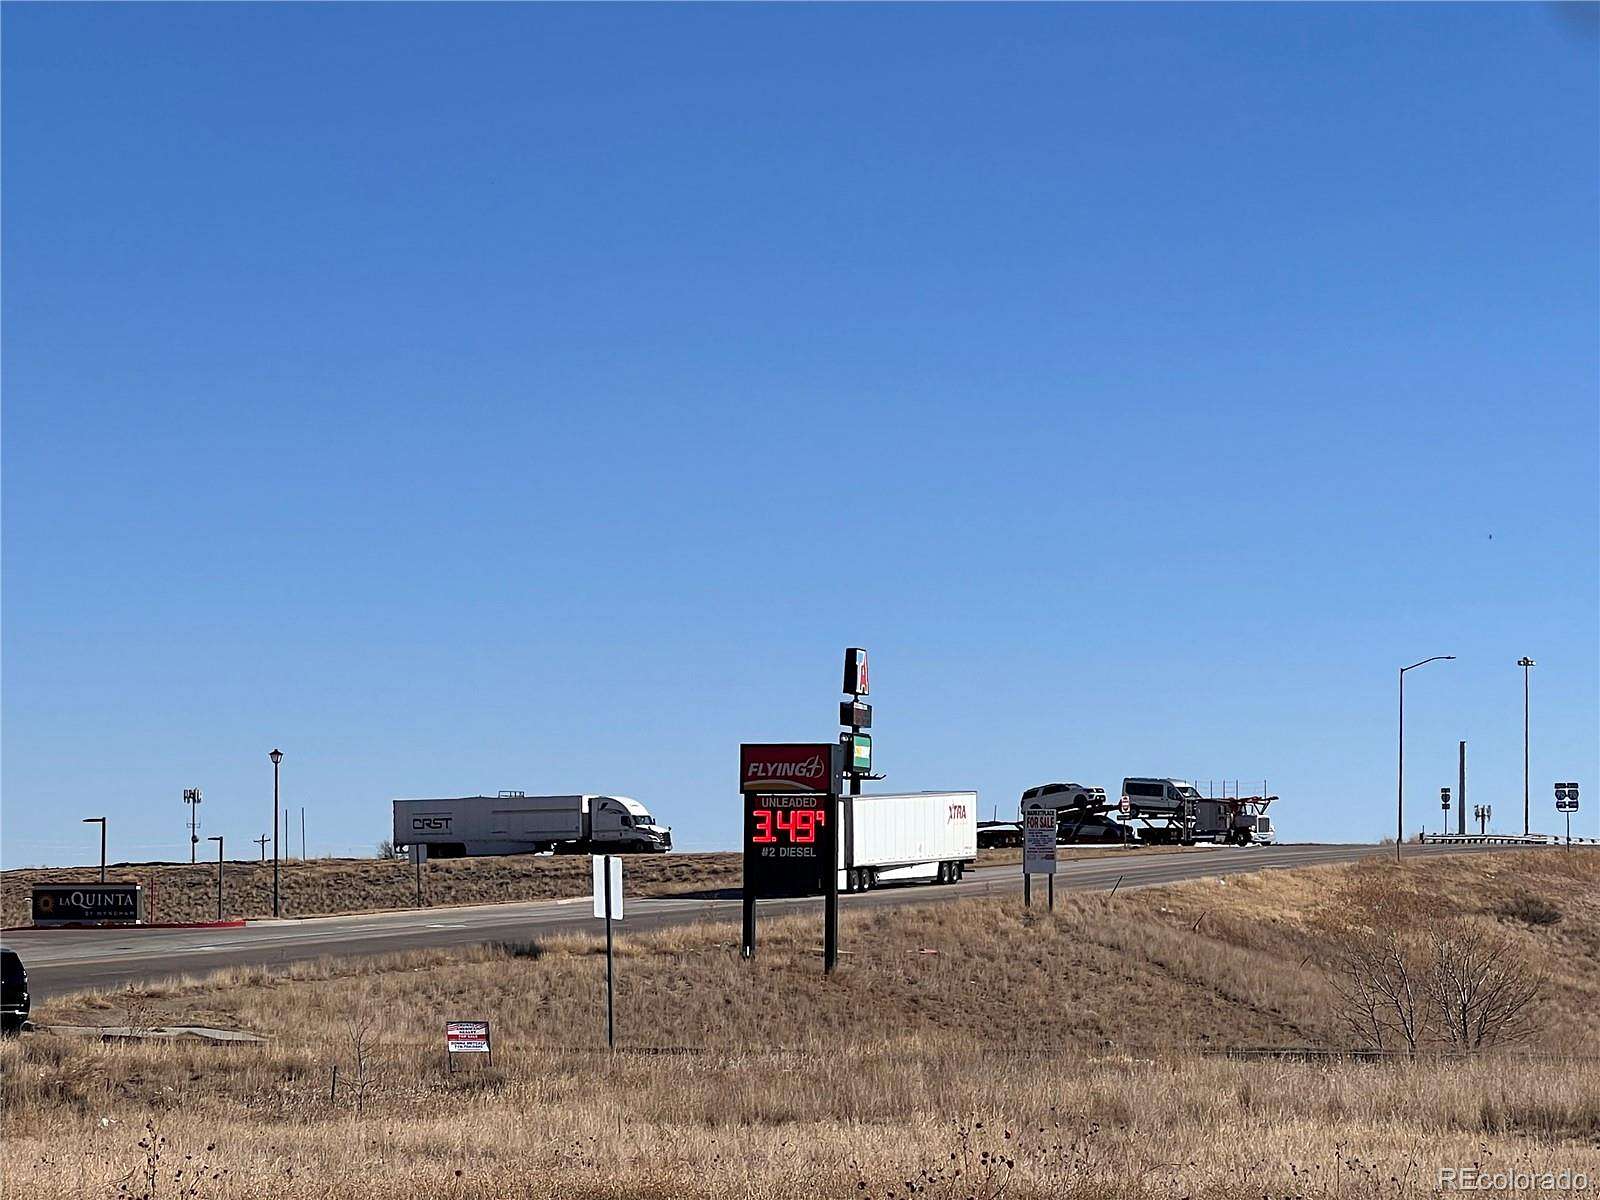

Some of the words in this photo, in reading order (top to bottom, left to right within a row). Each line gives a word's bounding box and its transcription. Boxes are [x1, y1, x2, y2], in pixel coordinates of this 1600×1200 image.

[748, 763, 807, 777] FLYING
[761, 798, 817, 808] UNLEADED
[413, 817, 453, 830] CRST
[1027, 816, 1039, 829] FOR
[1040, 816, 1055, 829] SALE
[762, 848, 776, 857] #2
[779, 848, 817, 857] DIESEL
[59, 897, 70, 906] LA
[71, 891, 133, 909] QUINTA
